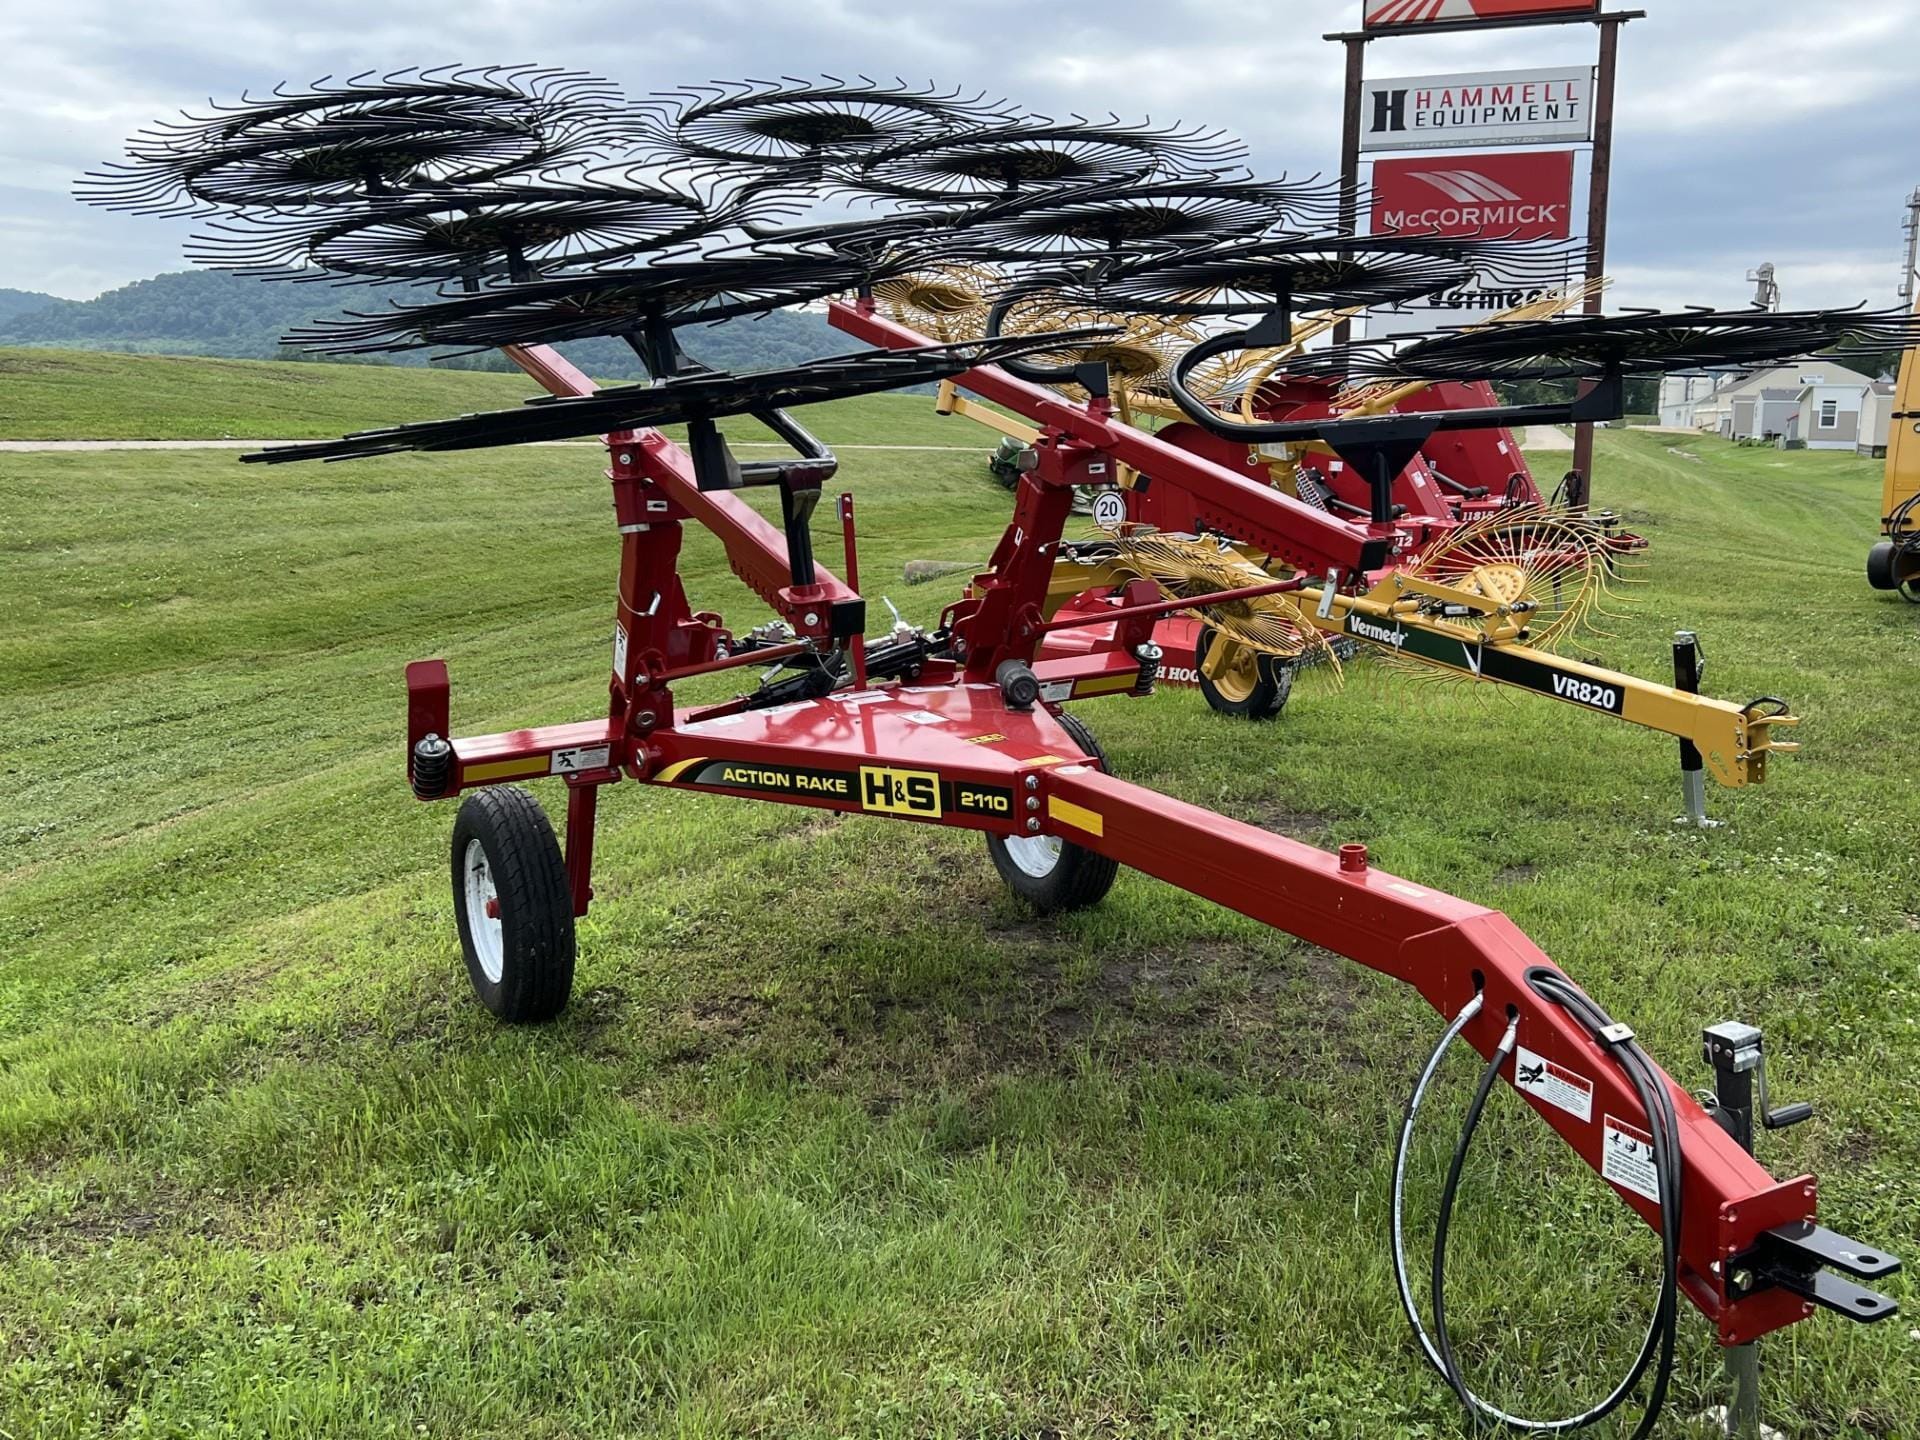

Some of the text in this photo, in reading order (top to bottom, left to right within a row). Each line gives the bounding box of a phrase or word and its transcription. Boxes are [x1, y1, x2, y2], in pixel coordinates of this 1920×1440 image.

[1416, 82, 1579, 110] HAMMELL
[1415, 103, 1579, 127] EQUIPMENT
[1100, 501, 1118, 517] 20
[1350, 615, 1405, 647] Vermeer
[1552, 673, 1616, 709] VR820
[723, 767, 848, 793] ACTION RAKE
[864, 772, 936, 811] H&S
[961, 791, 1009, 811] 2110
